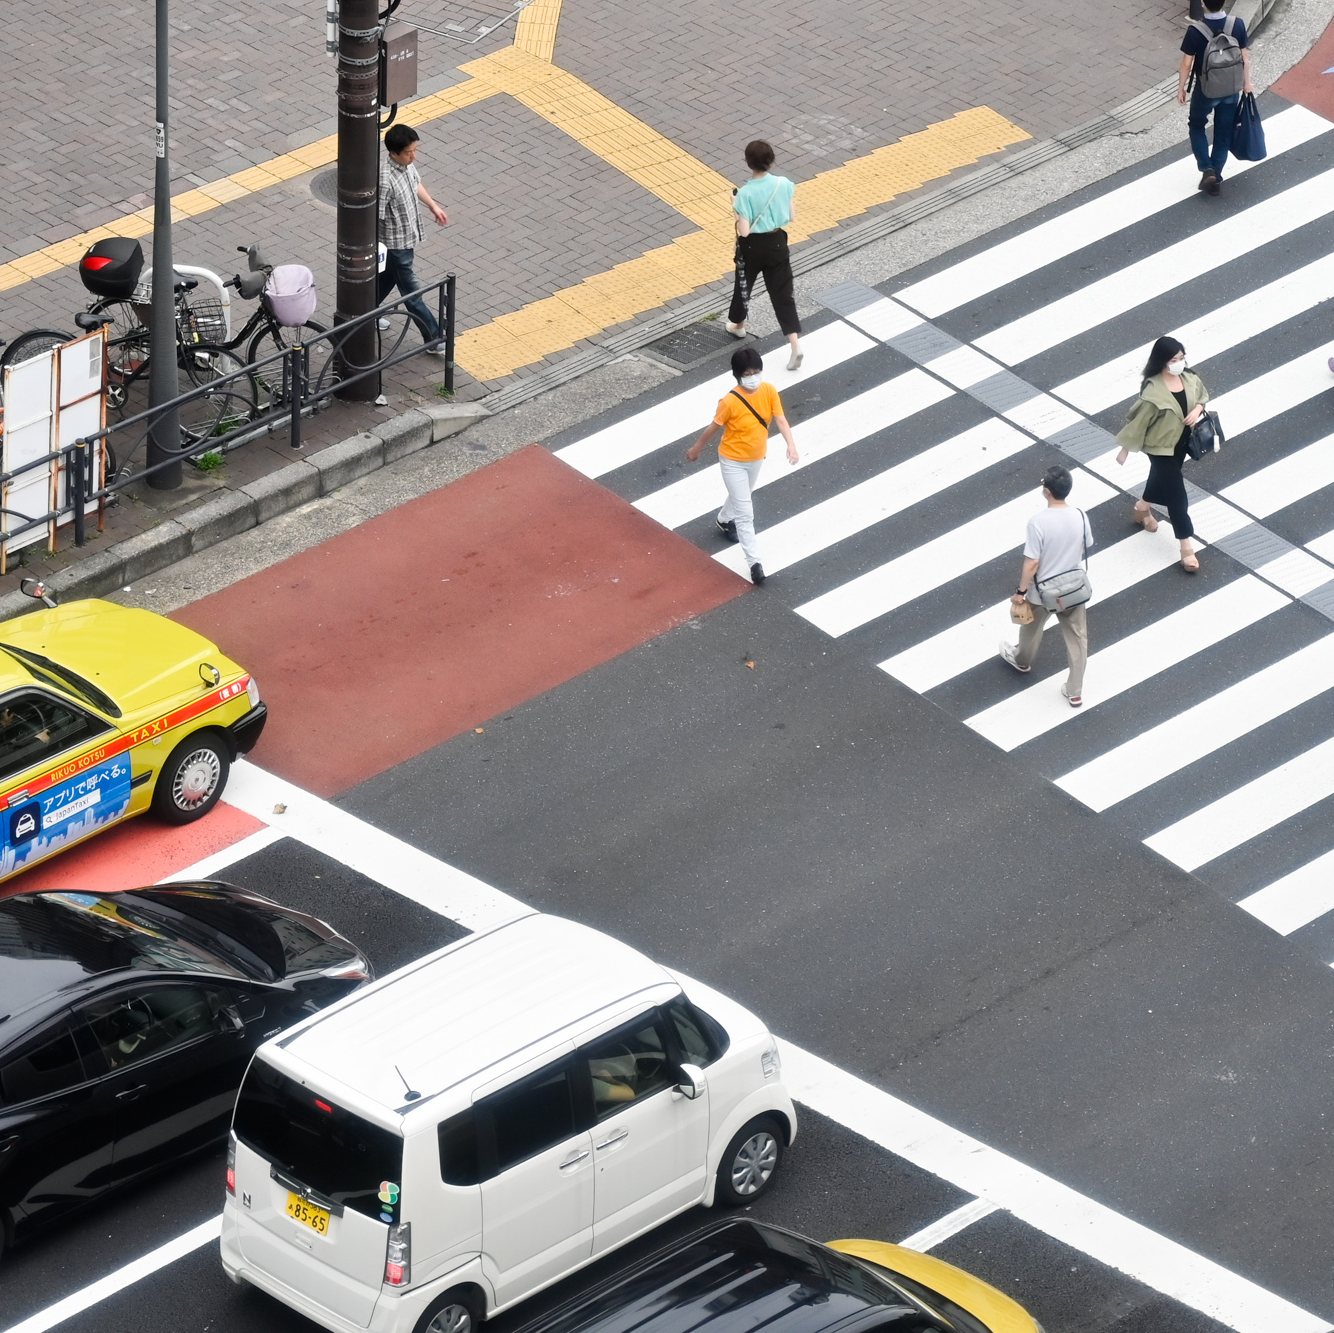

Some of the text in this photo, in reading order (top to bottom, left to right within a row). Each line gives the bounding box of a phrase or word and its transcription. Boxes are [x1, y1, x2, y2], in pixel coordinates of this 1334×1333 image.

[130, 719, 168, 743] TAXI
[51, 749, 105, 782] RIKUO KOTSU
[43, 764, 126, 813] アプリで呼べる。
[55, 798, 89, 820] JapanTaxi
[294, 1204, 327, 1232] 85-65
